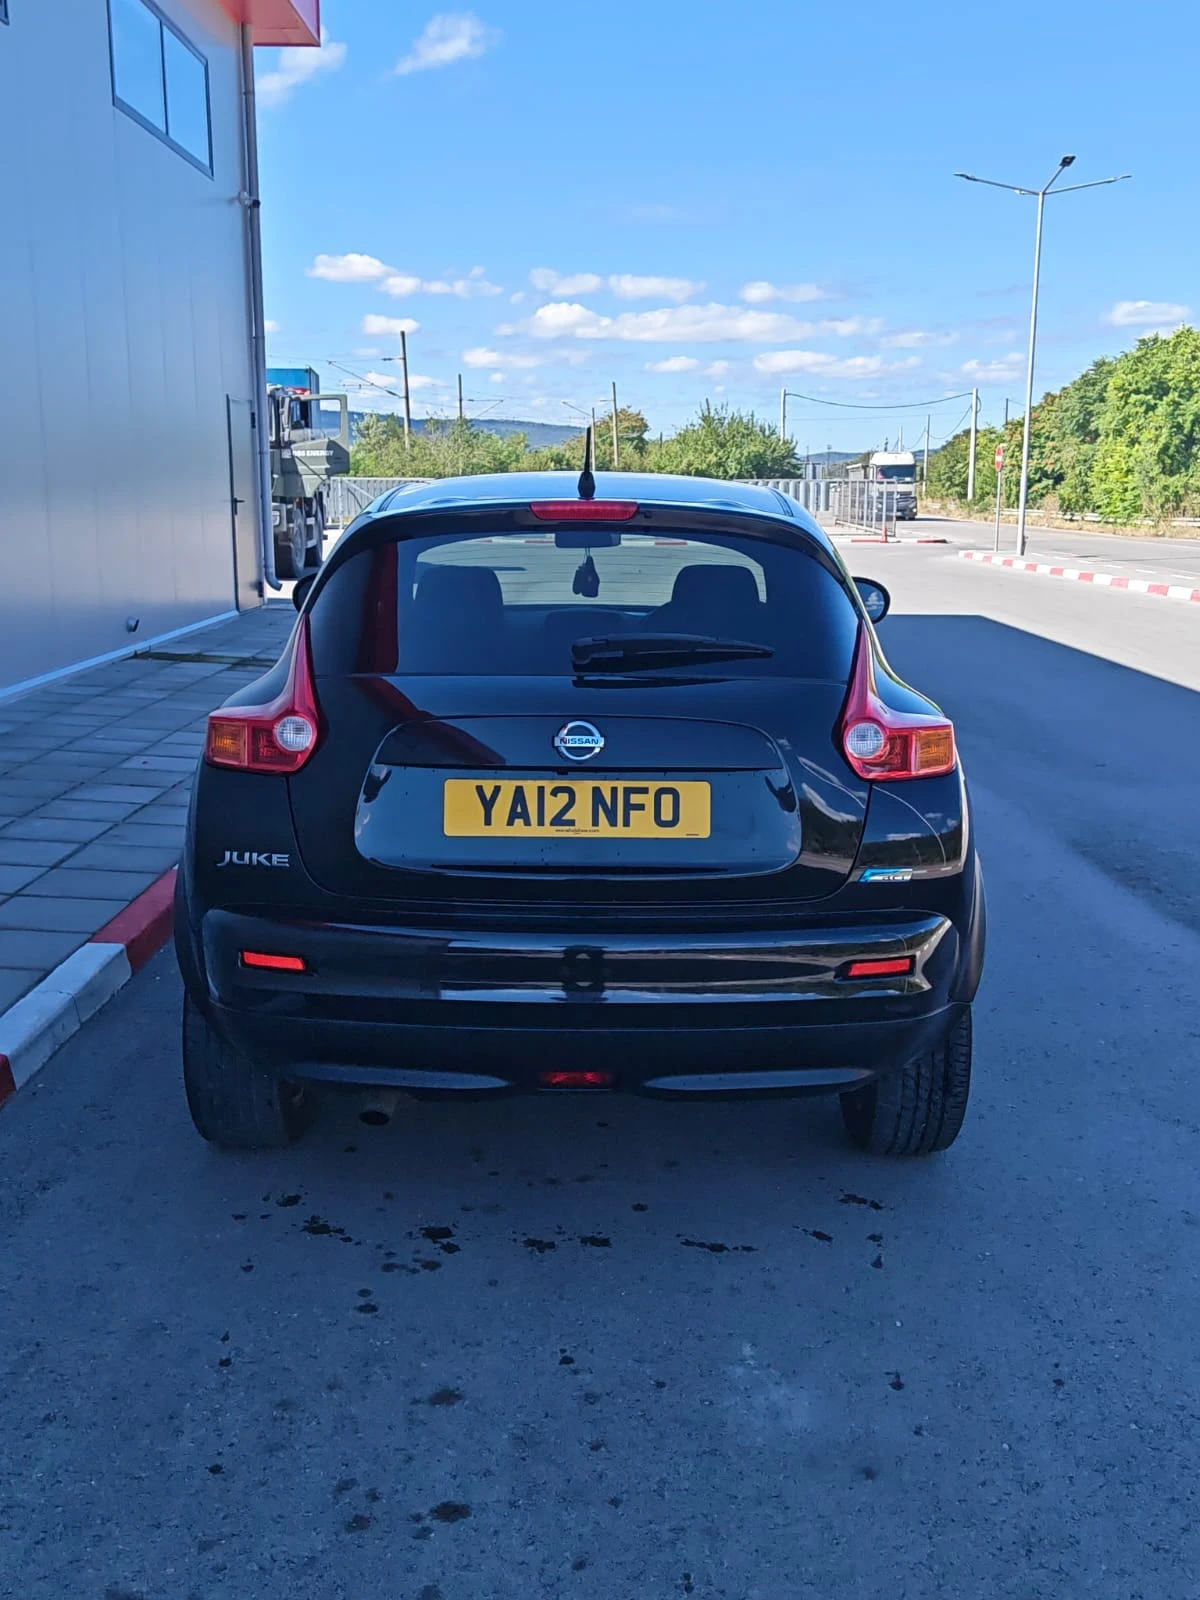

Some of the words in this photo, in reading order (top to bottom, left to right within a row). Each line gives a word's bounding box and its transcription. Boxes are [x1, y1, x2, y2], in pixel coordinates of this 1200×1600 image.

[559, 737, 599, 745] NISSAN
[475, 785, 577, 827] YA12
[591, 786, 681, 828] NFO
[216, 851, 290, 867] JUKE
